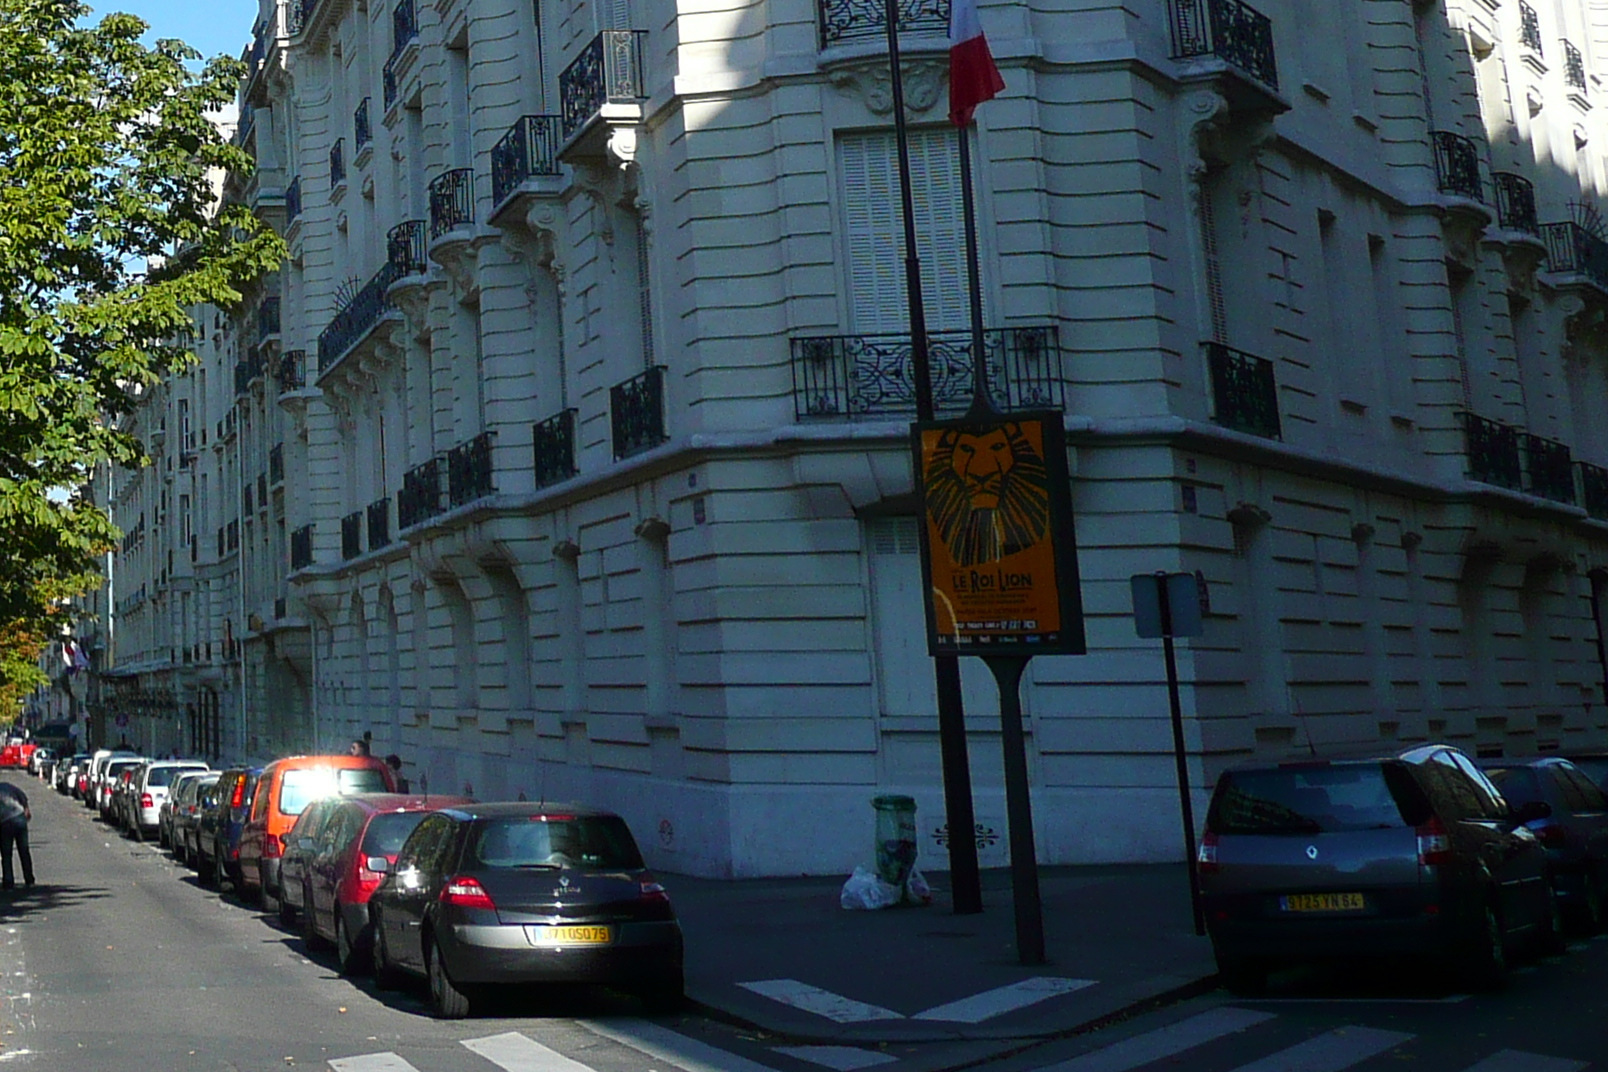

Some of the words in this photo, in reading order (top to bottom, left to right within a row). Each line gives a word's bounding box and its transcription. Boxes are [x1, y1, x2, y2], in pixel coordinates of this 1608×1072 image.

[952, 575, 967, 588] LE
[971, 570, 994, 593] ROI
[998, 569, 1033, 592] LION
